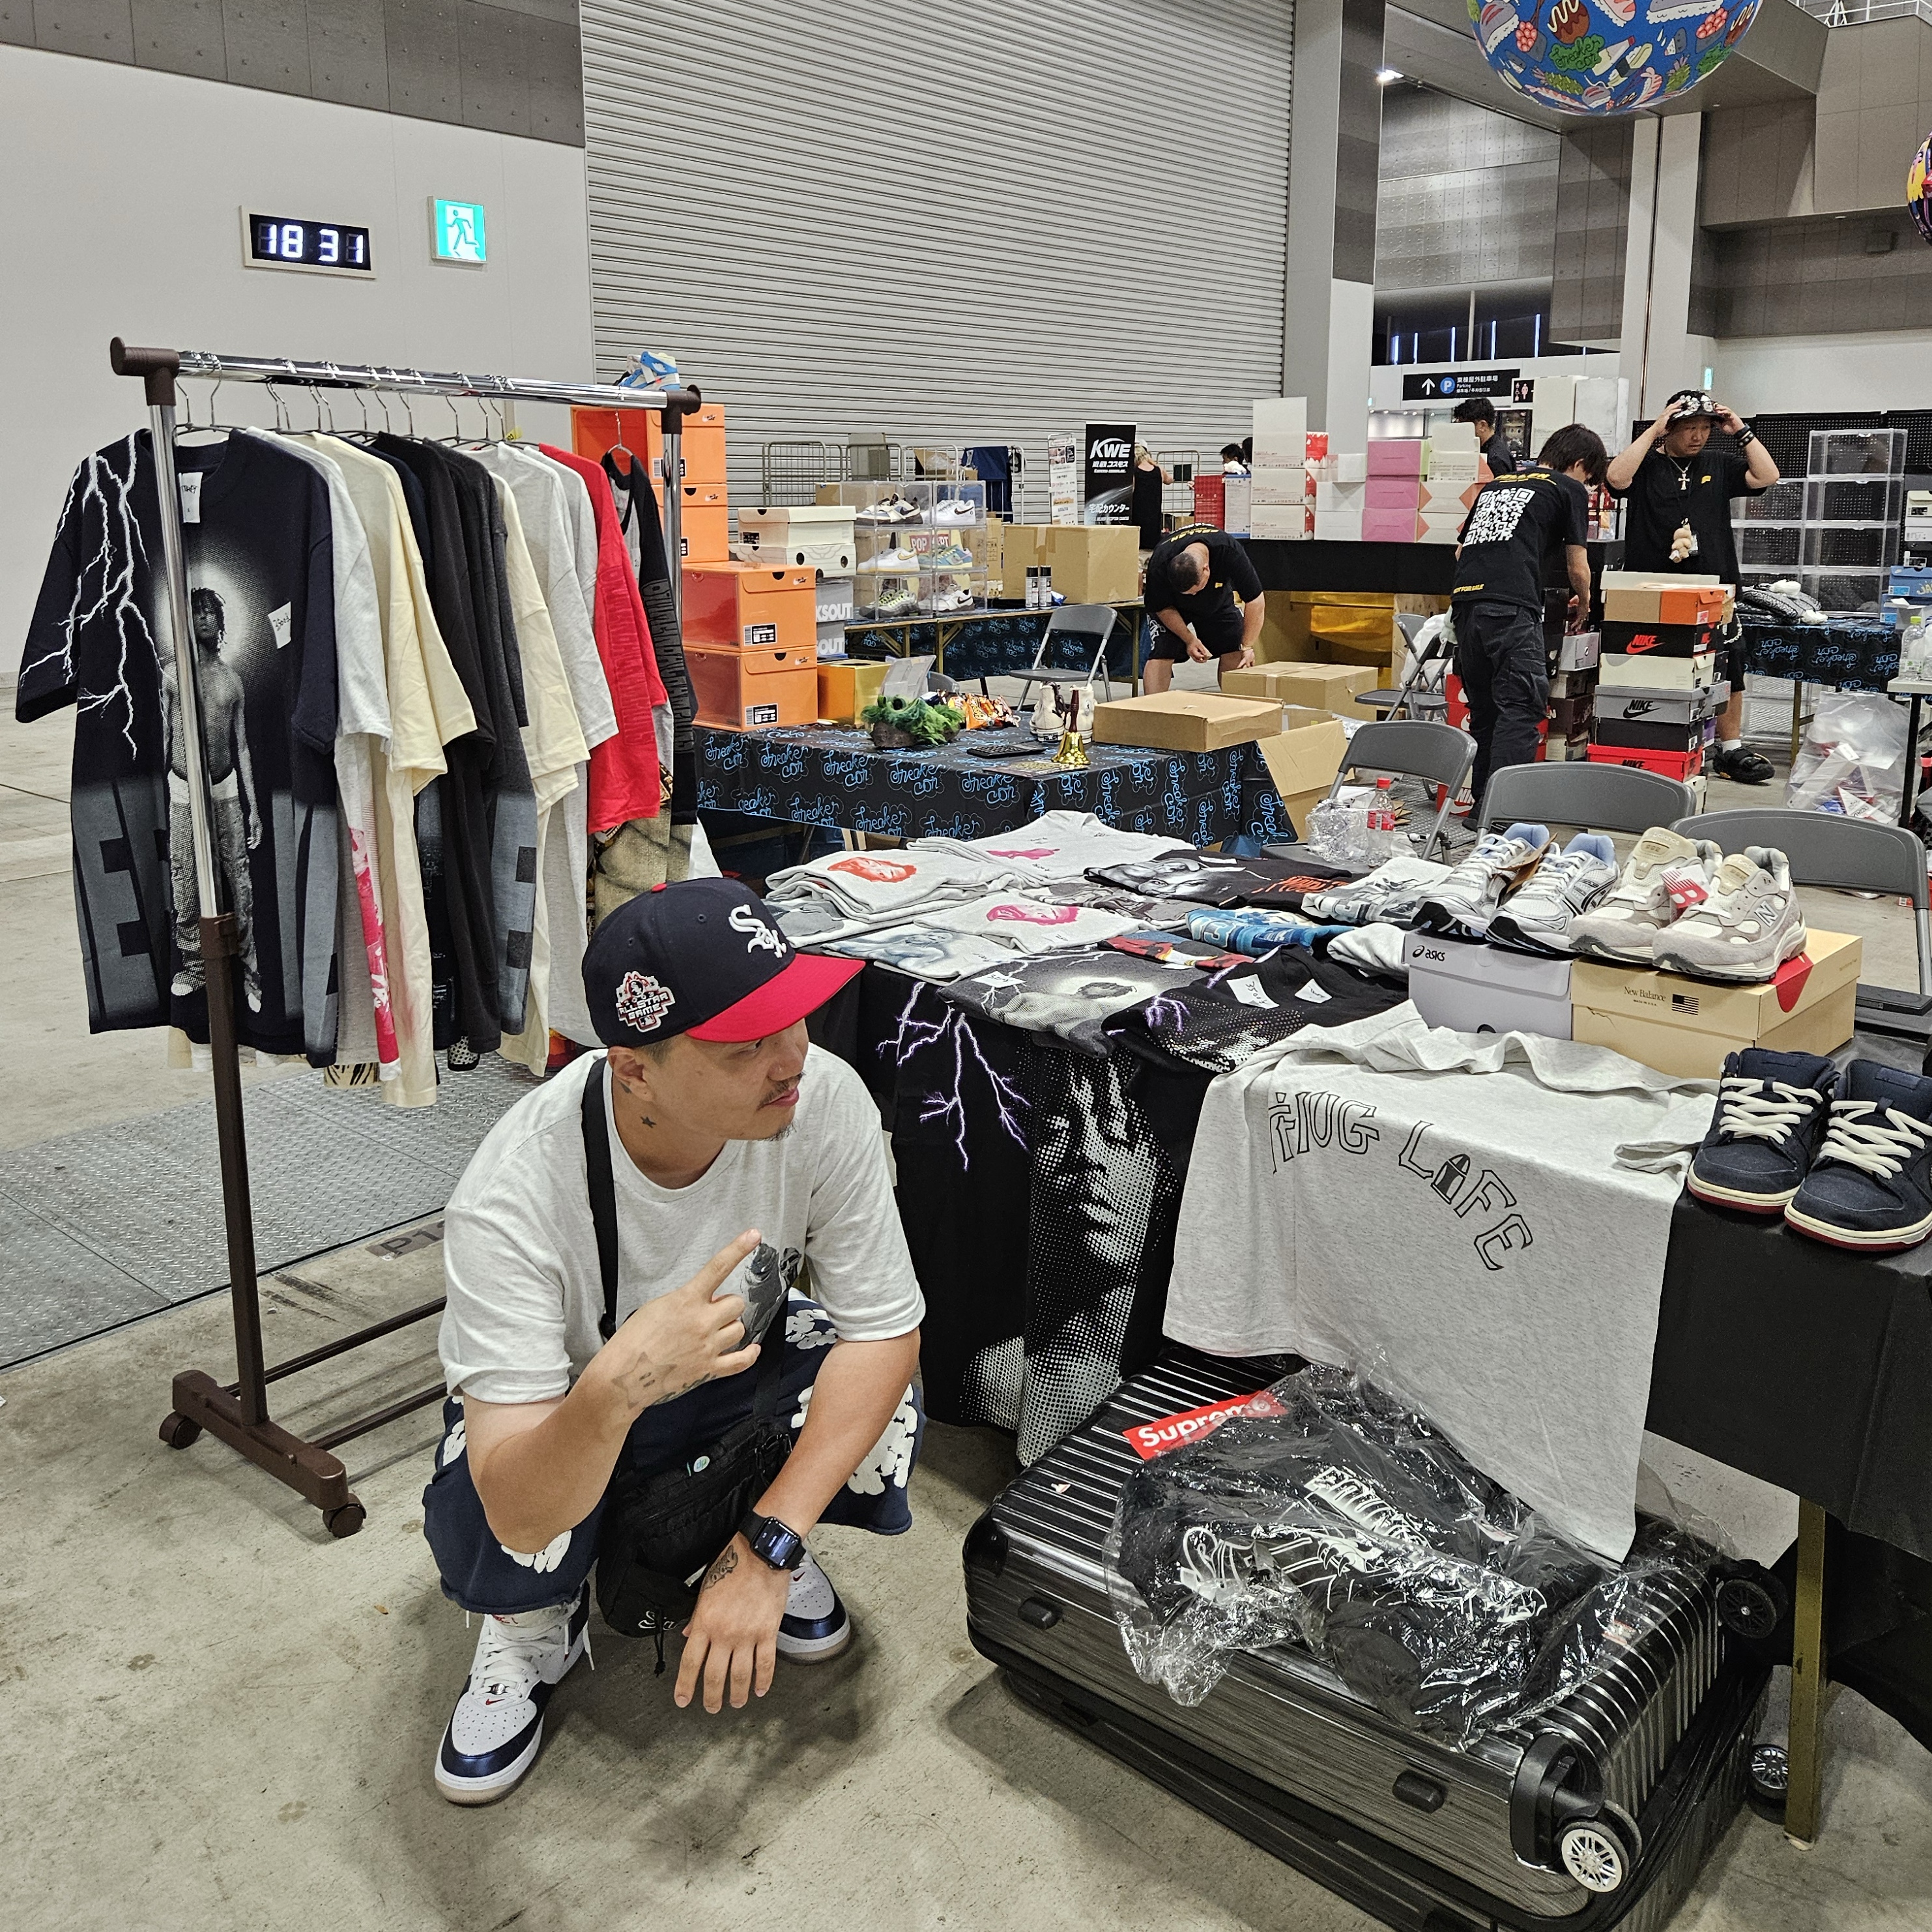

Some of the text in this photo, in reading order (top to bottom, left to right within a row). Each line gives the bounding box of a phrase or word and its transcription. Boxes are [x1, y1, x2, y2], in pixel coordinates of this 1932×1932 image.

[270, 224, 363, 263] 18 31
[1089, 438, 1131, 459] KWE
[1632, 635, 1658, 646] NIKE
[1628, 699, 1654, 711] NIKE
[1425, 948, 1446, 962] asics
[1624, 986, 1666, 1002] New Balance
[628, 1003, 662, 1020] GAME
